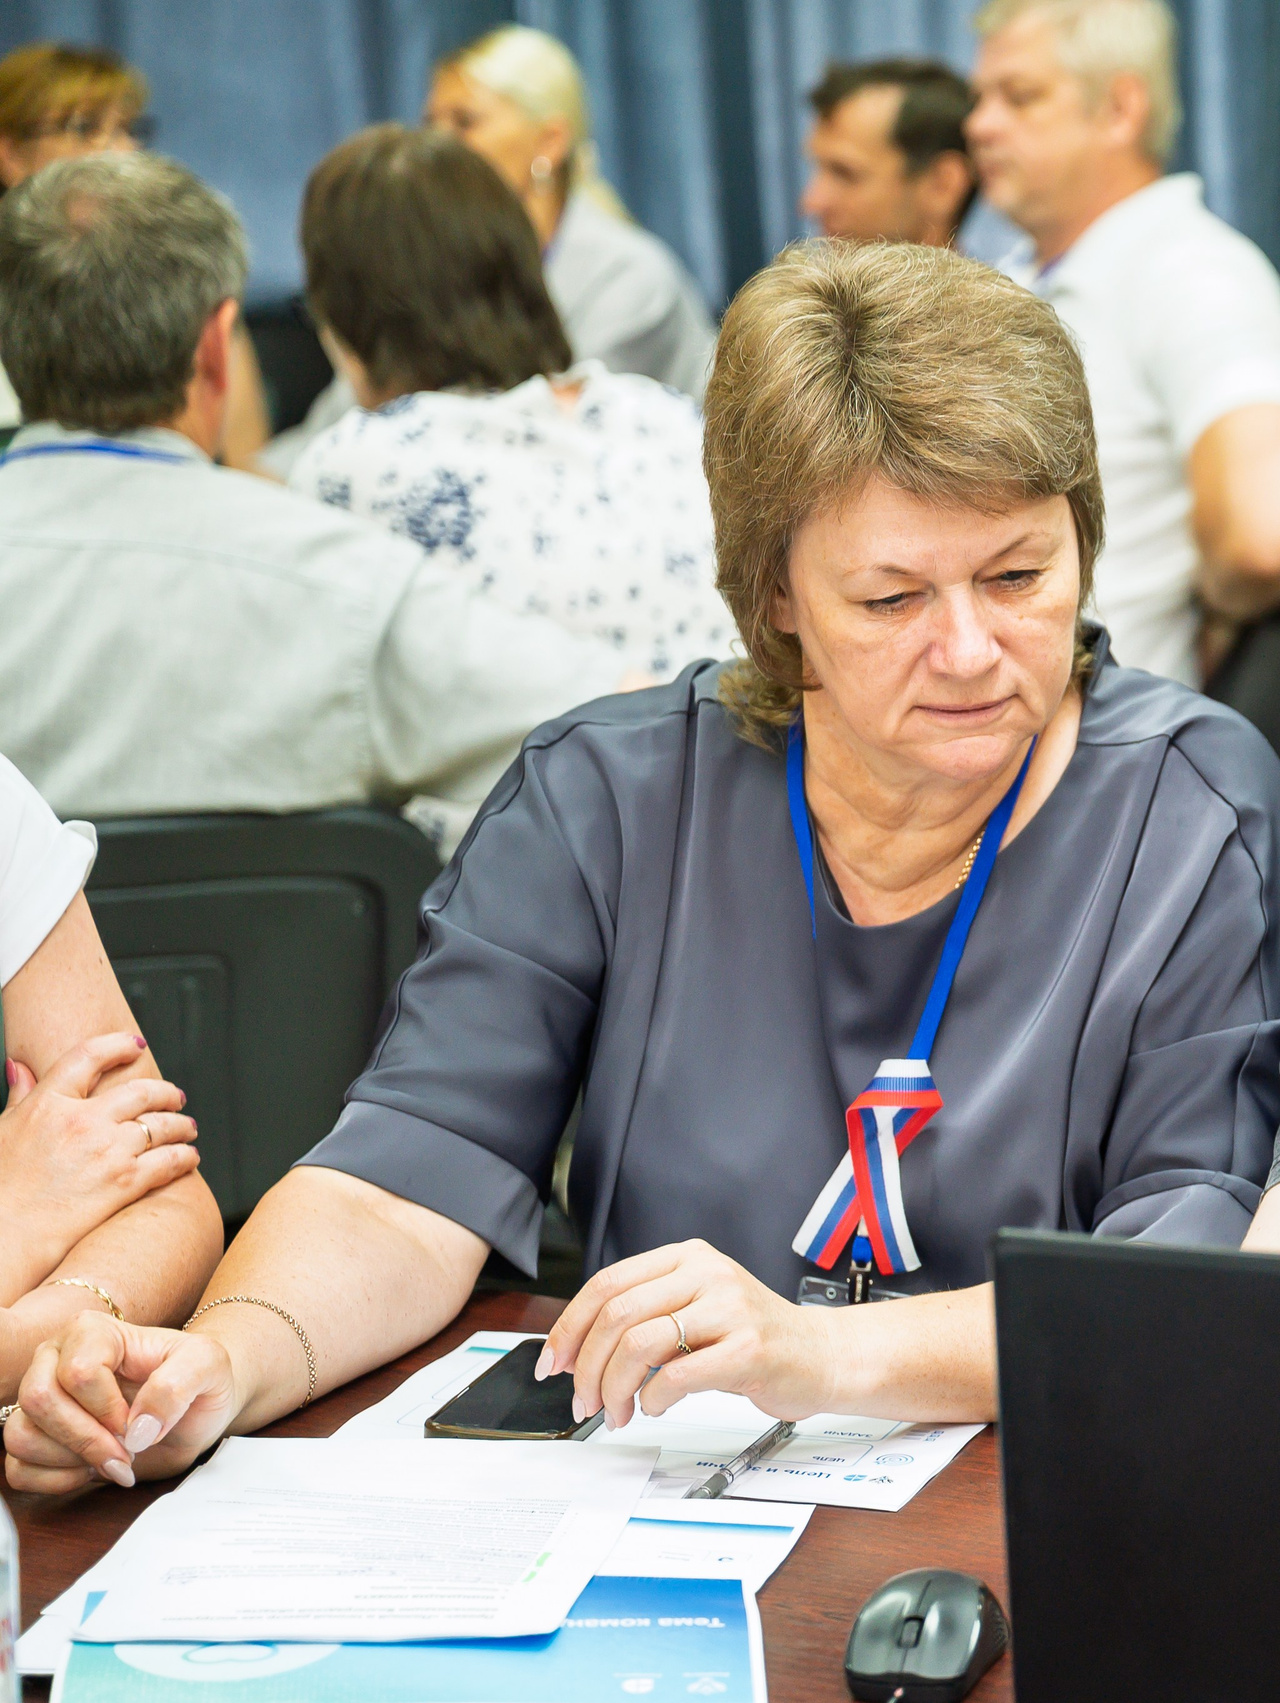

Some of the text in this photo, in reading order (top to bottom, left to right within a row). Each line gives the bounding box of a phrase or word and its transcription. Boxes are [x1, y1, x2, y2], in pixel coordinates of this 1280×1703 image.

[822, 1430, 873, 1439] ЗАДАЧИ
[812, 1455, 846, 1463] ЦЕЛЬ
[765, 1466, 778, 1475] и
[782, 1467, 832, 1480] Цель
[657, 1616, 725, 1628] Тема
